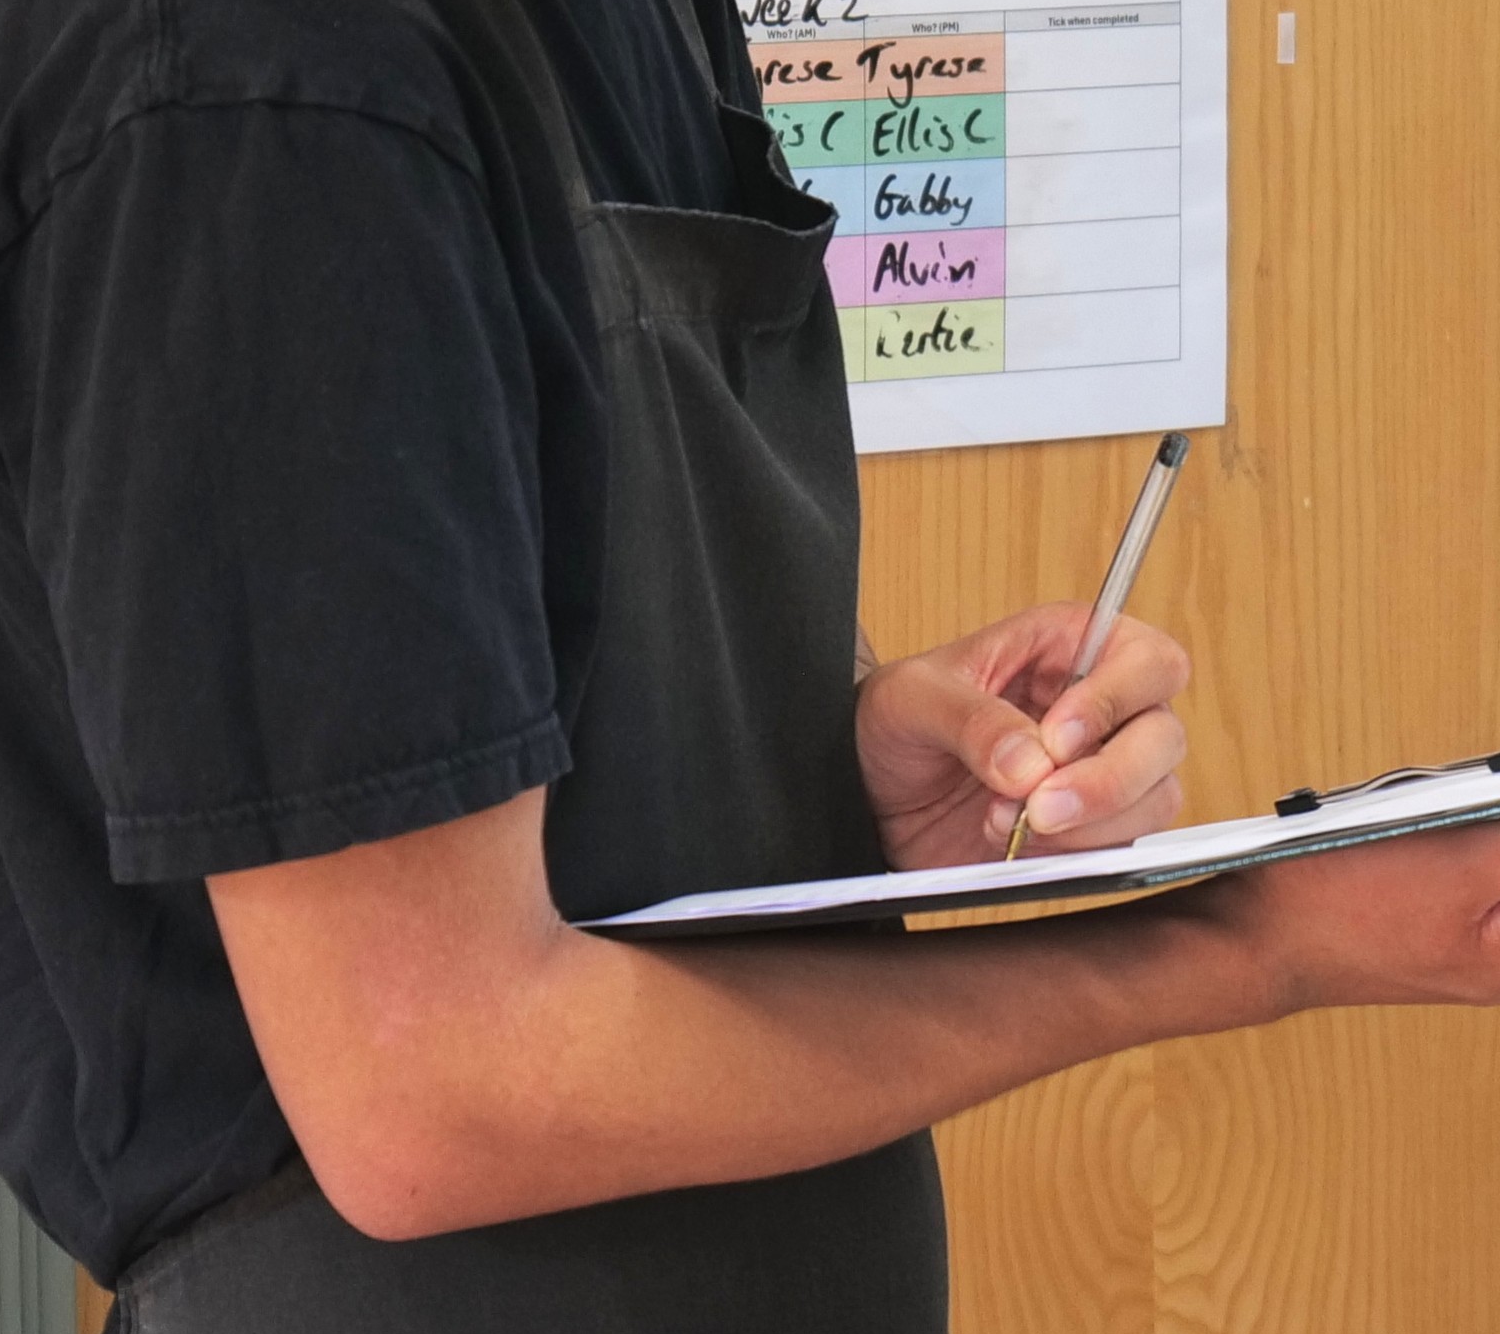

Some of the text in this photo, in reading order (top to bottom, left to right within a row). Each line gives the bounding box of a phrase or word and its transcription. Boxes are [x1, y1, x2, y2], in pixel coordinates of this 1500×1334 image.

[767, 27, 817, 40] Who? (AM)
[911, 20, 960, 34] Who? (PM)
[1048, 12, 1140, 27] Tick when completed
[855, 40, 988, 110] Tyrese
[872, 106, 996, 157] Ellis C
[874, 172, 974, 227] Gabby
[872, 240, 979, 293] Alvin
